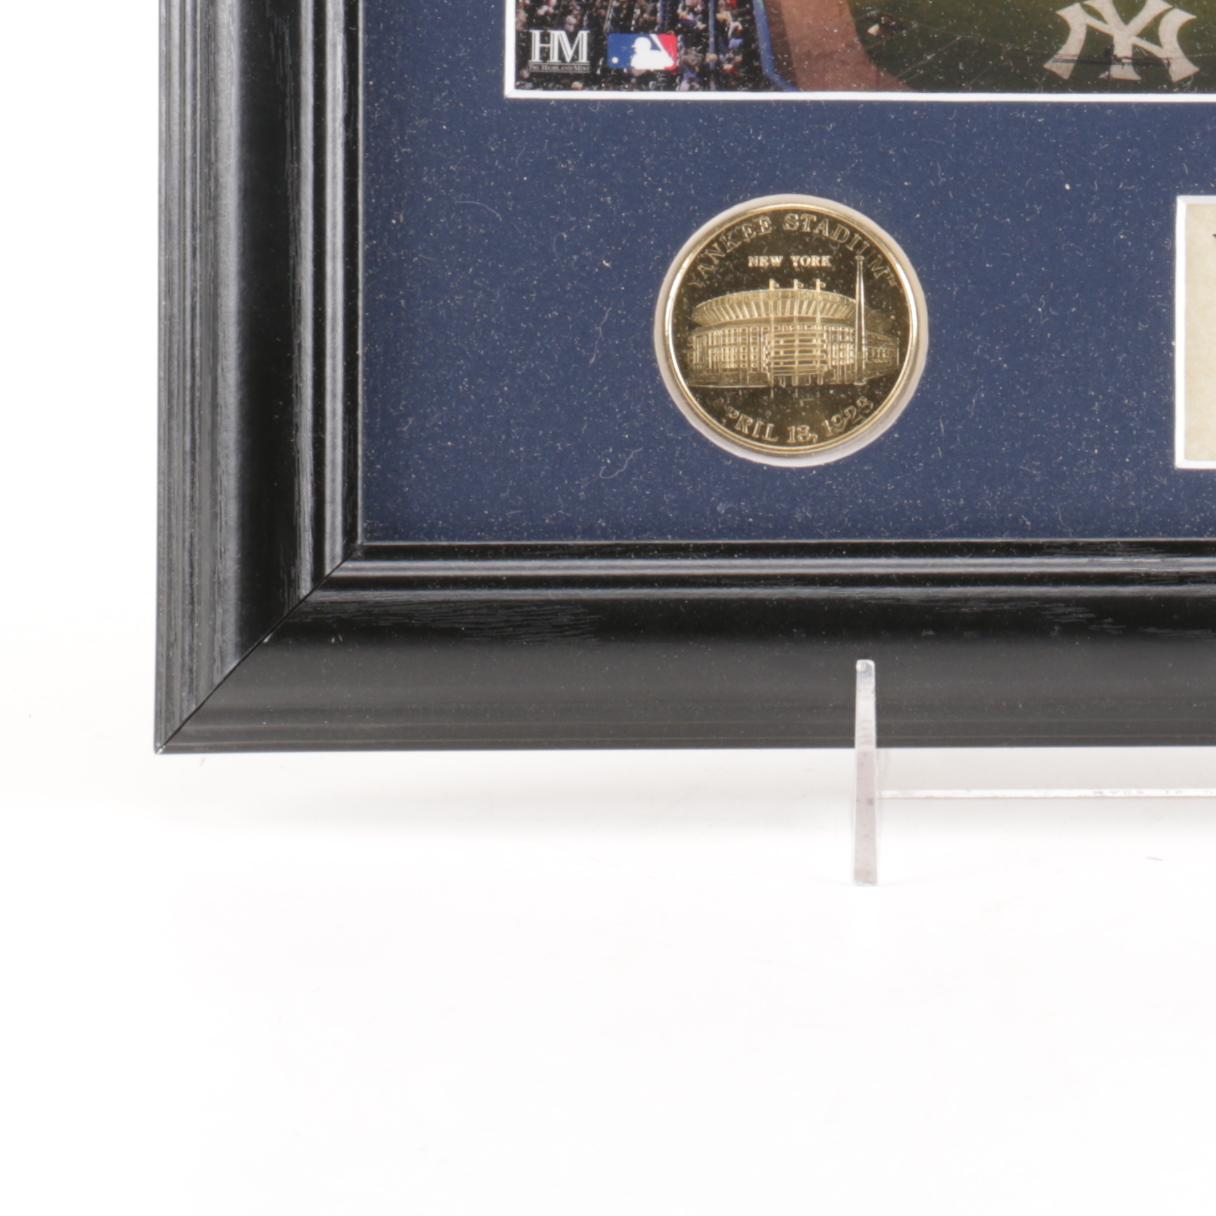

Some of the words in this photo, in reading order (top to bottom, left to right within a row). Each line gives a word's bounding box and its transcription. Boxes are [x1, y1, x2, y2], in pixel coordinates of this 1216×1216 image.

[529, 29, 590, 62] HM
[688, 215, 775, 288] YANKEE
[748, 255, 784, 267] NEW
[791, 255, 832, 267] YORK
